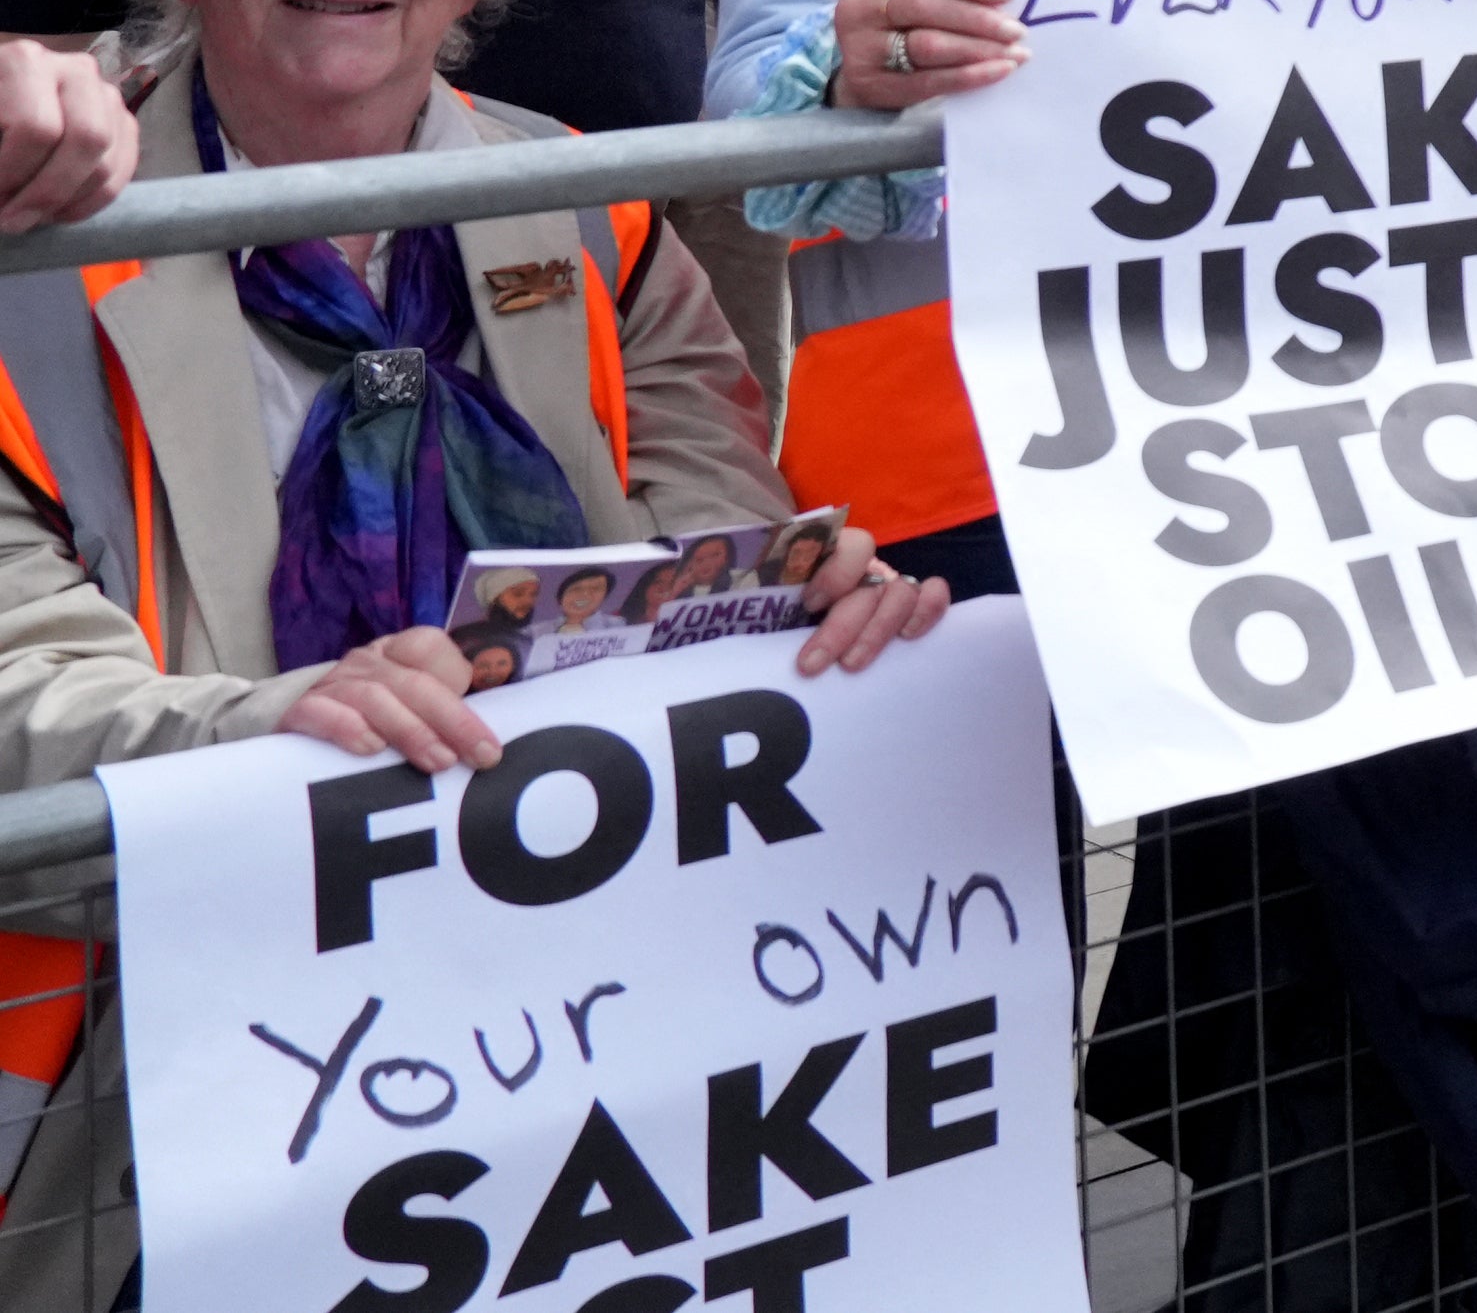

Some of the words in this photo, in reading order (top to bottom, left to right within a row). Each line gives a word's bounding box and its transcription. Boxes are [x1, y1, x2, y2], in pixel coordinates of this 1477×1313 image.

[652, 595, 787, 638] WOMEN
[307, 686, 823, 953] FOR
[249, 983, 626, 1165] Your
[752, 871, 1019, 1005] own
[326, 995, 998, 1313] SAKE
